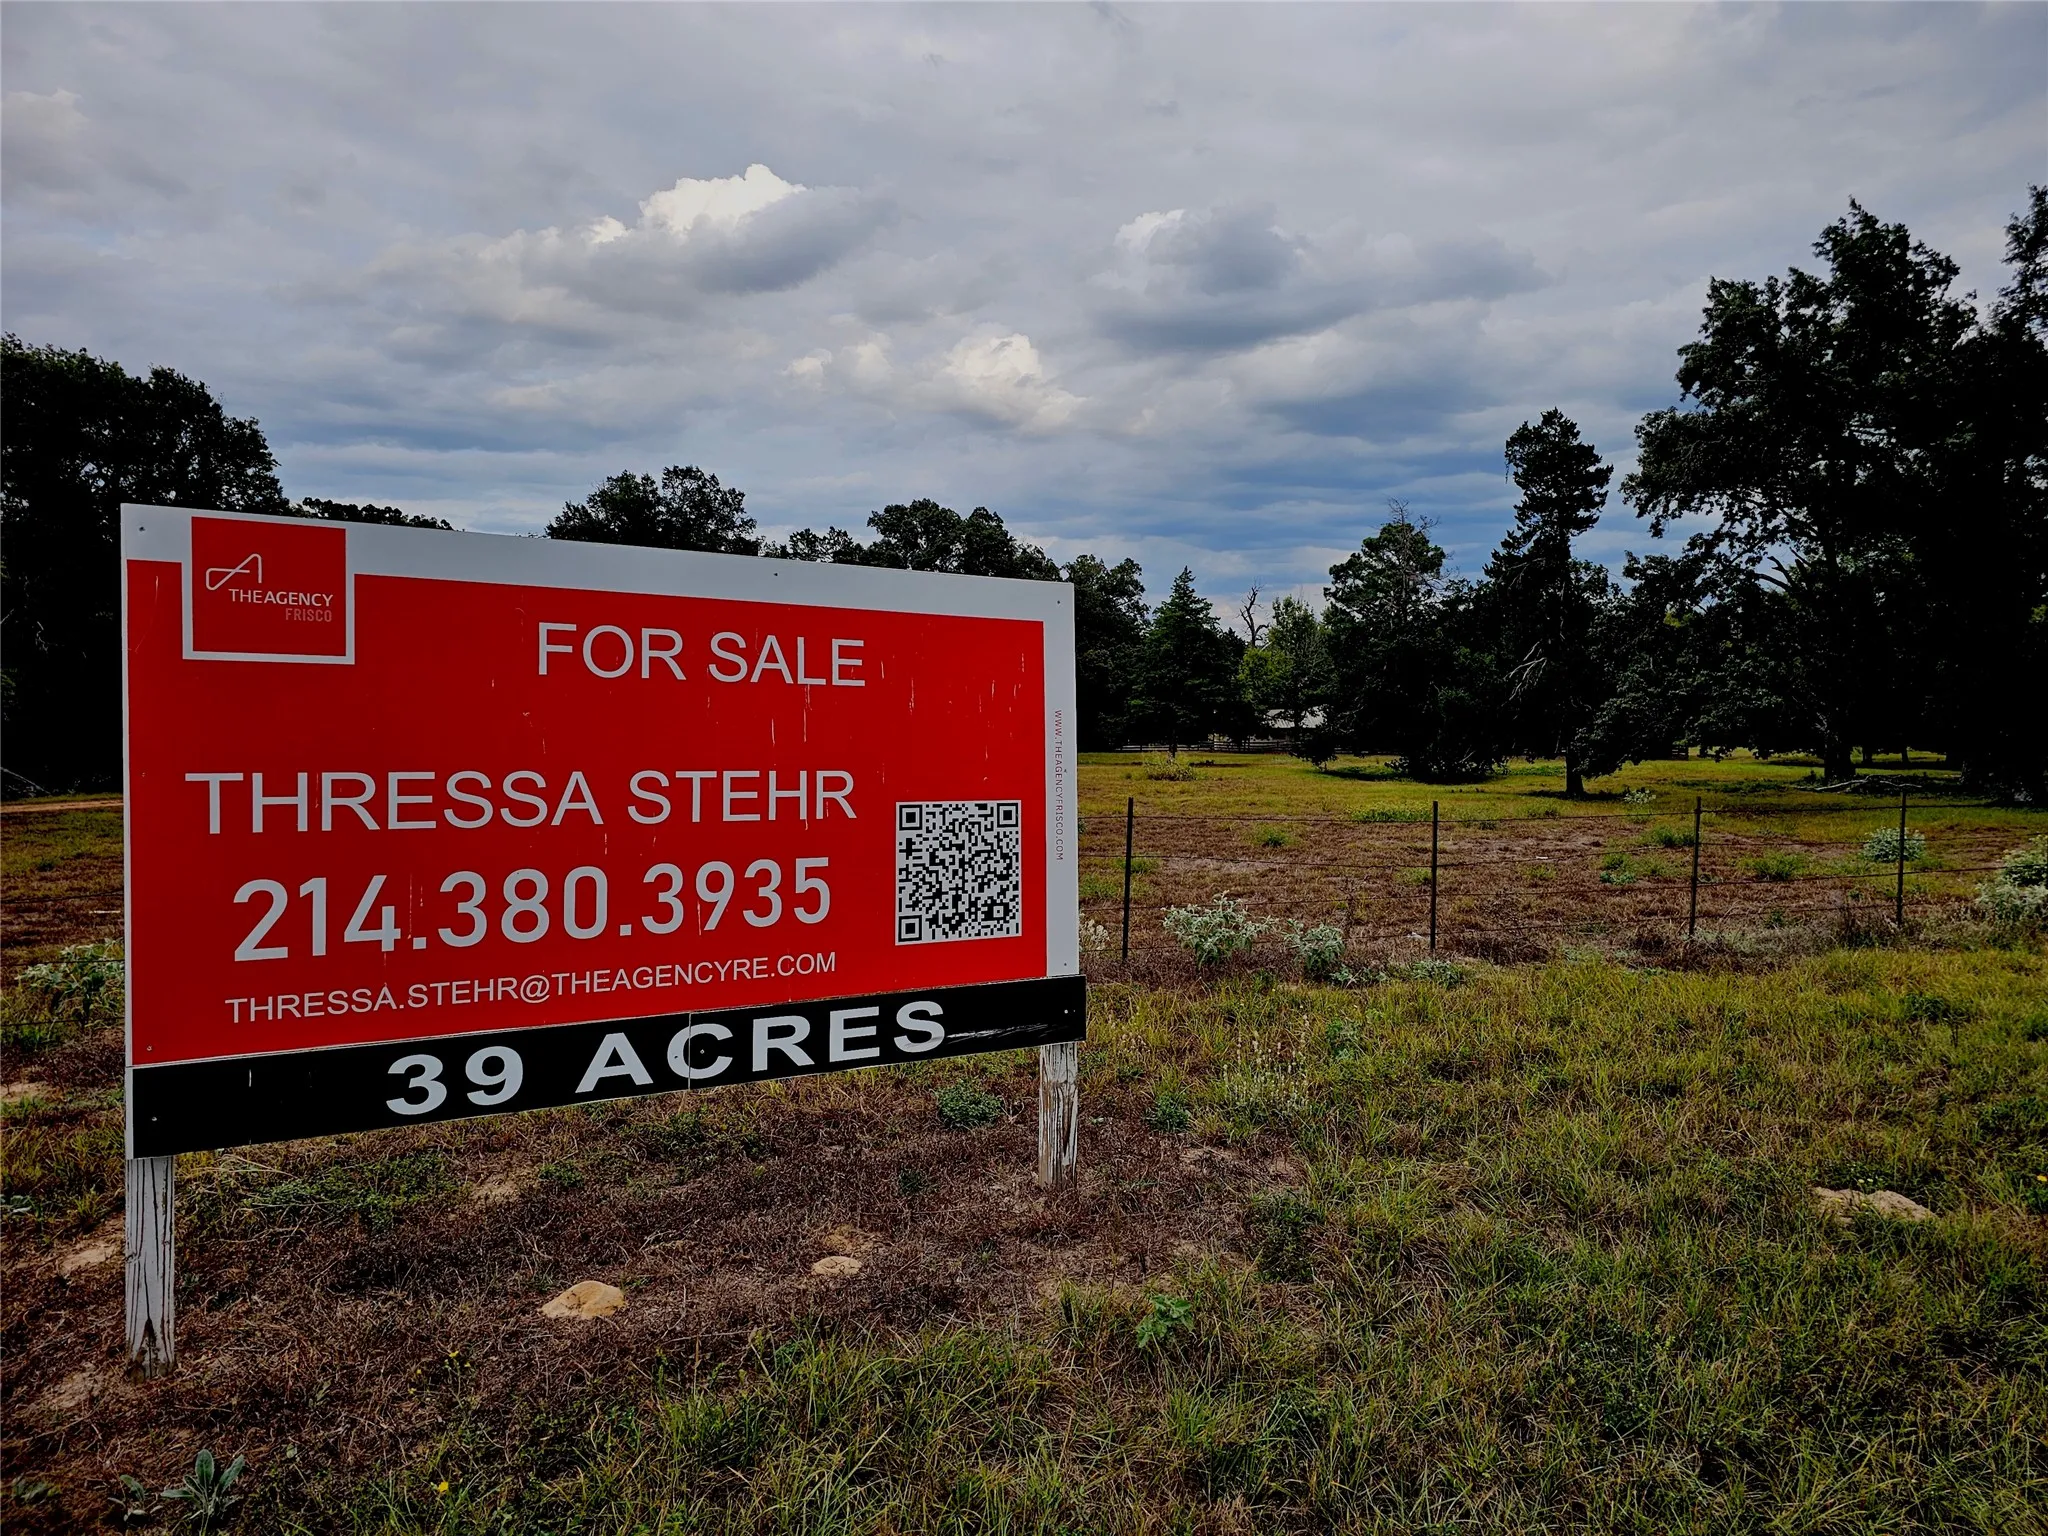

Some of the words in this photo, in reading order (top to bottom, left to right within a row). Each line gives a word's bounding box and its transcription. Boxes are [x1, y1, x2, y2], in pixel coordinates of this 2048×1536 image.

[285, 608, 333, 623] FRISCO
[538, 622, 687, 681] FOR
[708, 631, 866, 687] SALE
[185, 770, 604, 834] THRESSA
[627, 770, 857, 825] STEHR
[1054, 710, 1064, 861] WWW.THEAGENCYFRISCO.COM
[233, 856, 831, 962] 214.380.3935
[225, 952, 837, 1024] THRESSA.STEHR@THEAGENCYRE.COM
[385, 1045, 524, 1116] 39
[575, 1000, 945, 1094] ACRES
